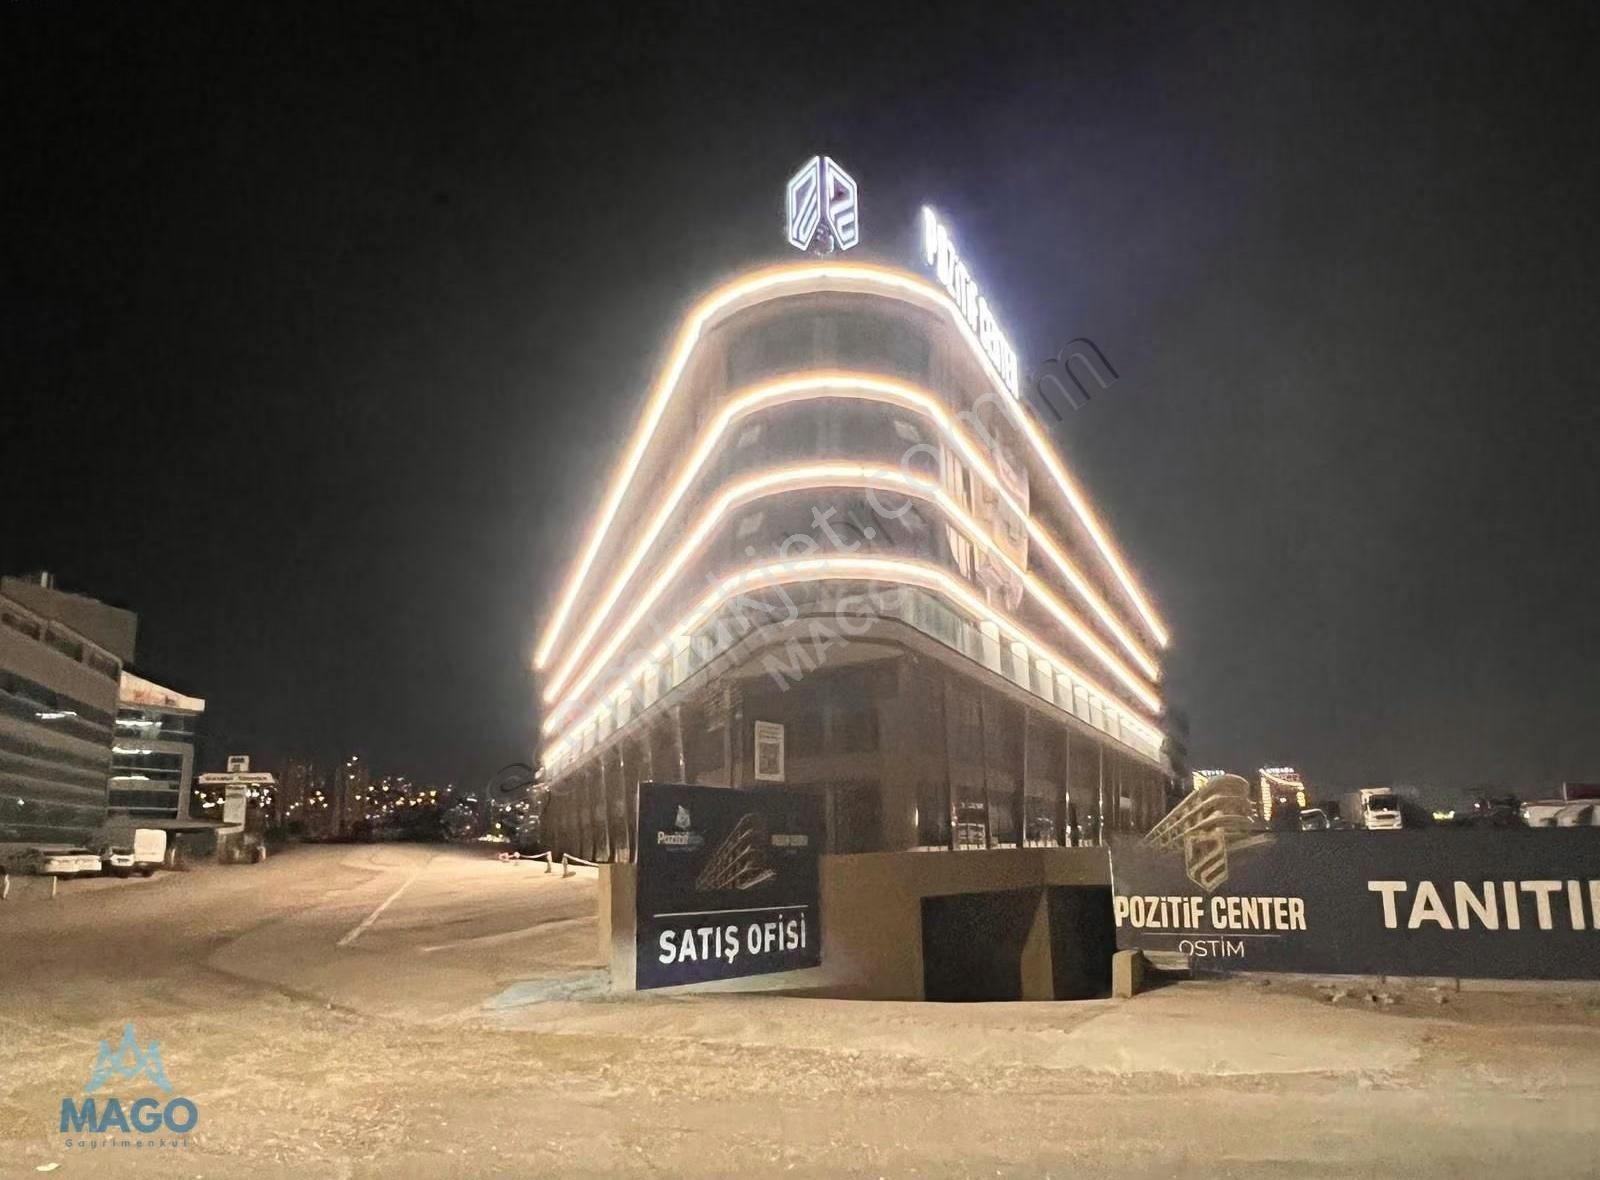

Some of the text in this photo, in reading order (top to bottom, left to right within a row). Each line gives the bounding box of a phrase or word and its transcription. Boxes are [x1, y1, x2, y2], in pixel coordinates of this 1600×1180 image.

[1211, 896, 1307, 931] CENTER
[1367, 879, 1600, 930] TANITI
[658, 911, 806, 965] SATIŞ OFİSİ
[1178, 935, 1246, 958] OSTİM
